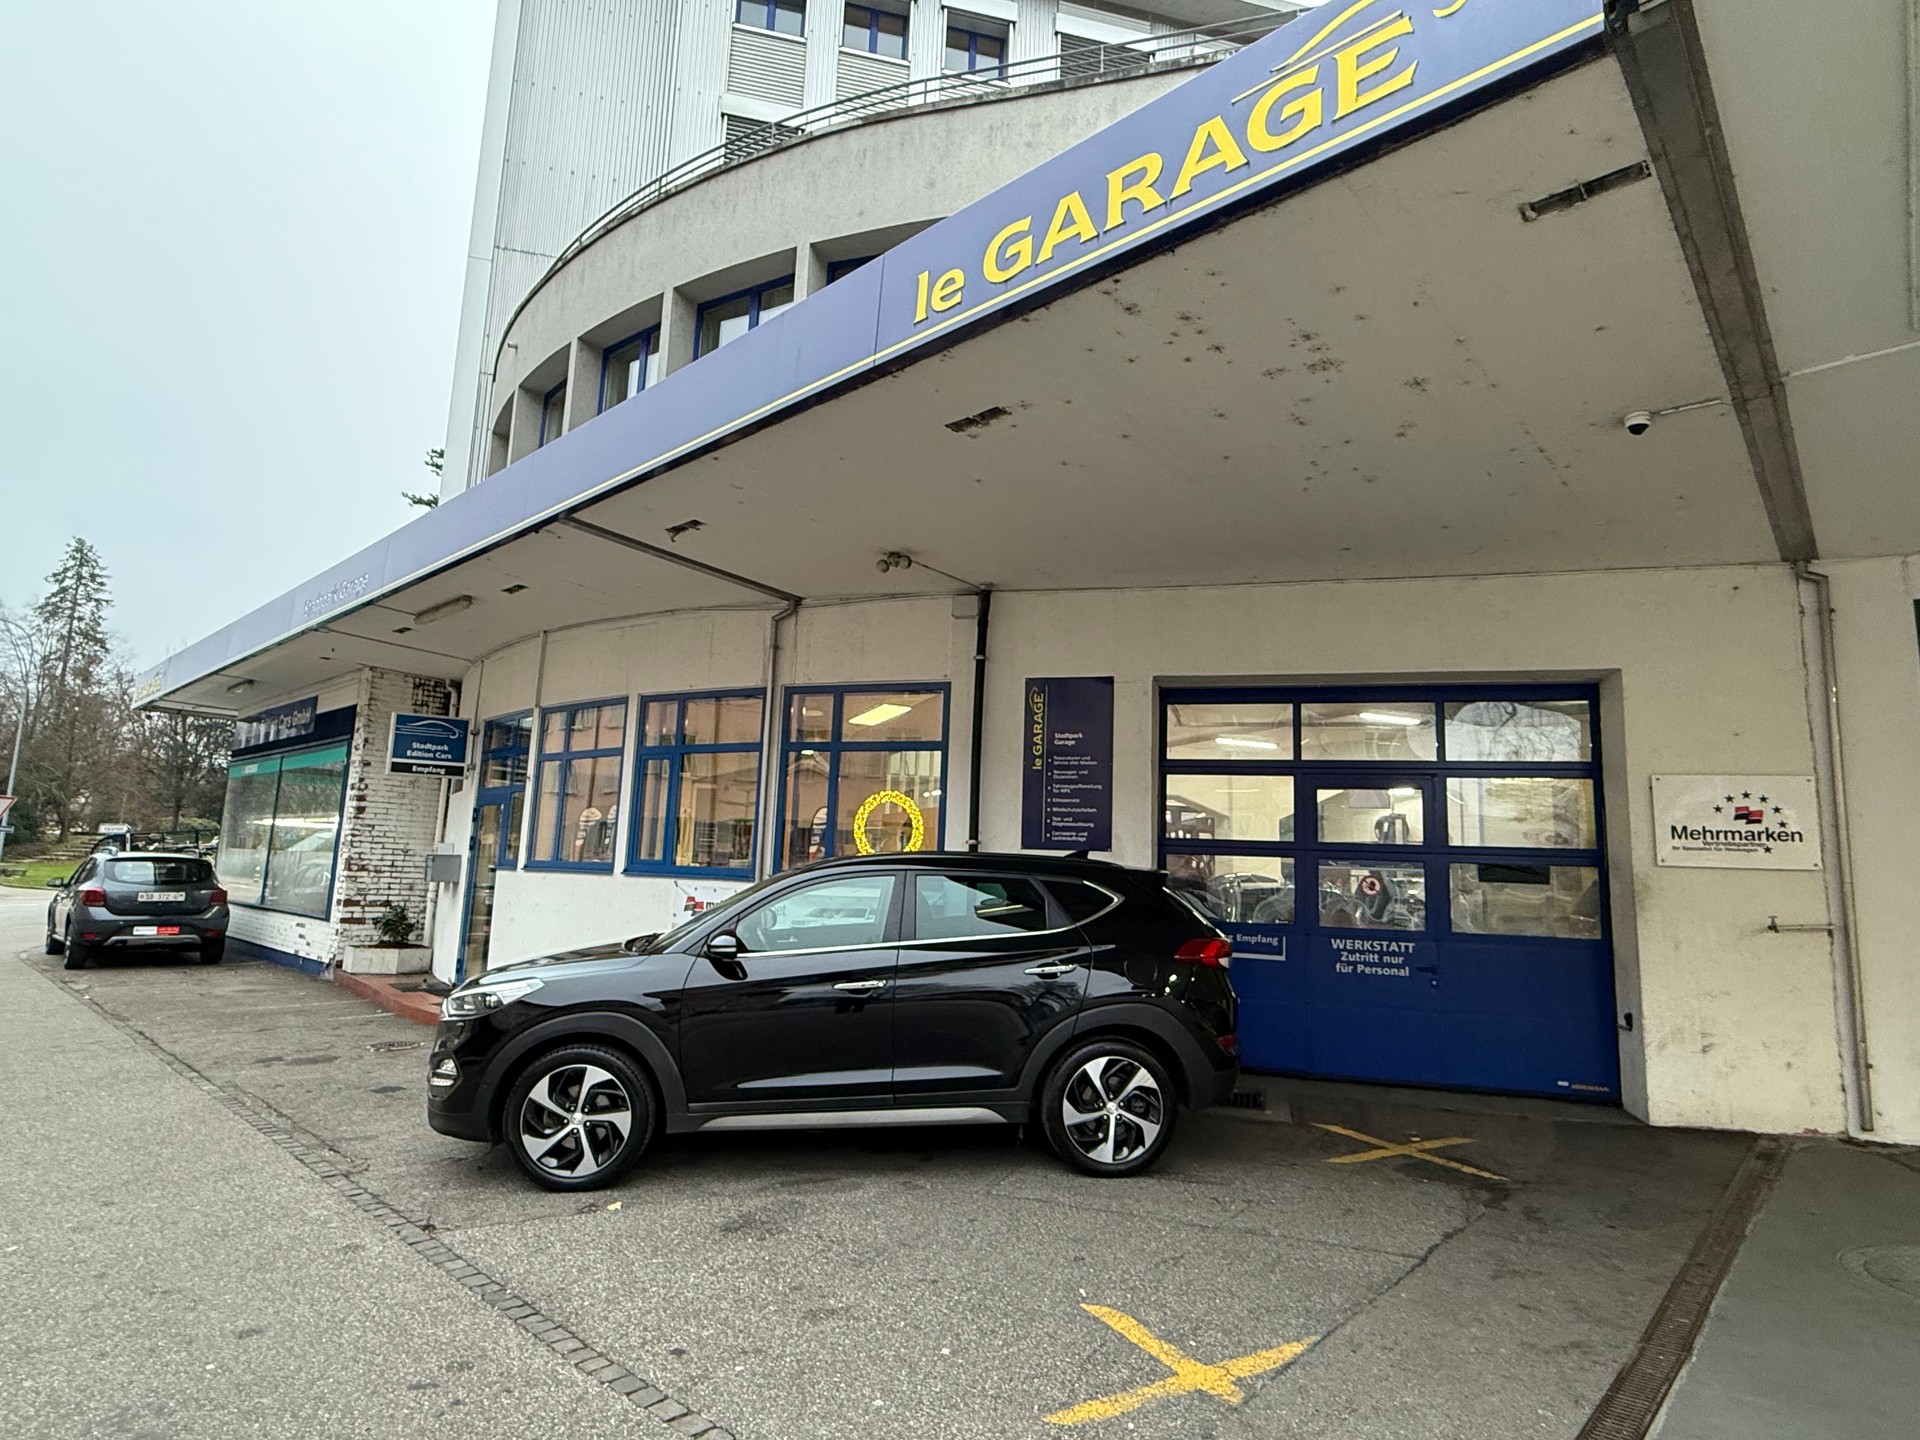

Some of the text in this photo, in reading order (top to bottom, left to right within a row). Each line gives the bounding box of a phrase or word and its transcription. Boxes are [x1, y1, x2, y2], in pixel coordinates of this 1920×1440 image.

[914, 15, 1419, 325] le GARAGE
[1032, 693, 1044, 770] le GARAGE
[412, 741, 449, 752] Stadtpark
[406, 749, 452, 760] Edition Cars
[412, 765, 446, 775] Empfang
[1670, 825, 1803, 843] Mehrmarken
[1236, 934, 1279, 947] Empfang
[1331, 938, 1415, 953] WERKSTATT
[1340, 951, 1404, 964] Zutritt nur
[1336, 962, 1410, 977] für Personal
